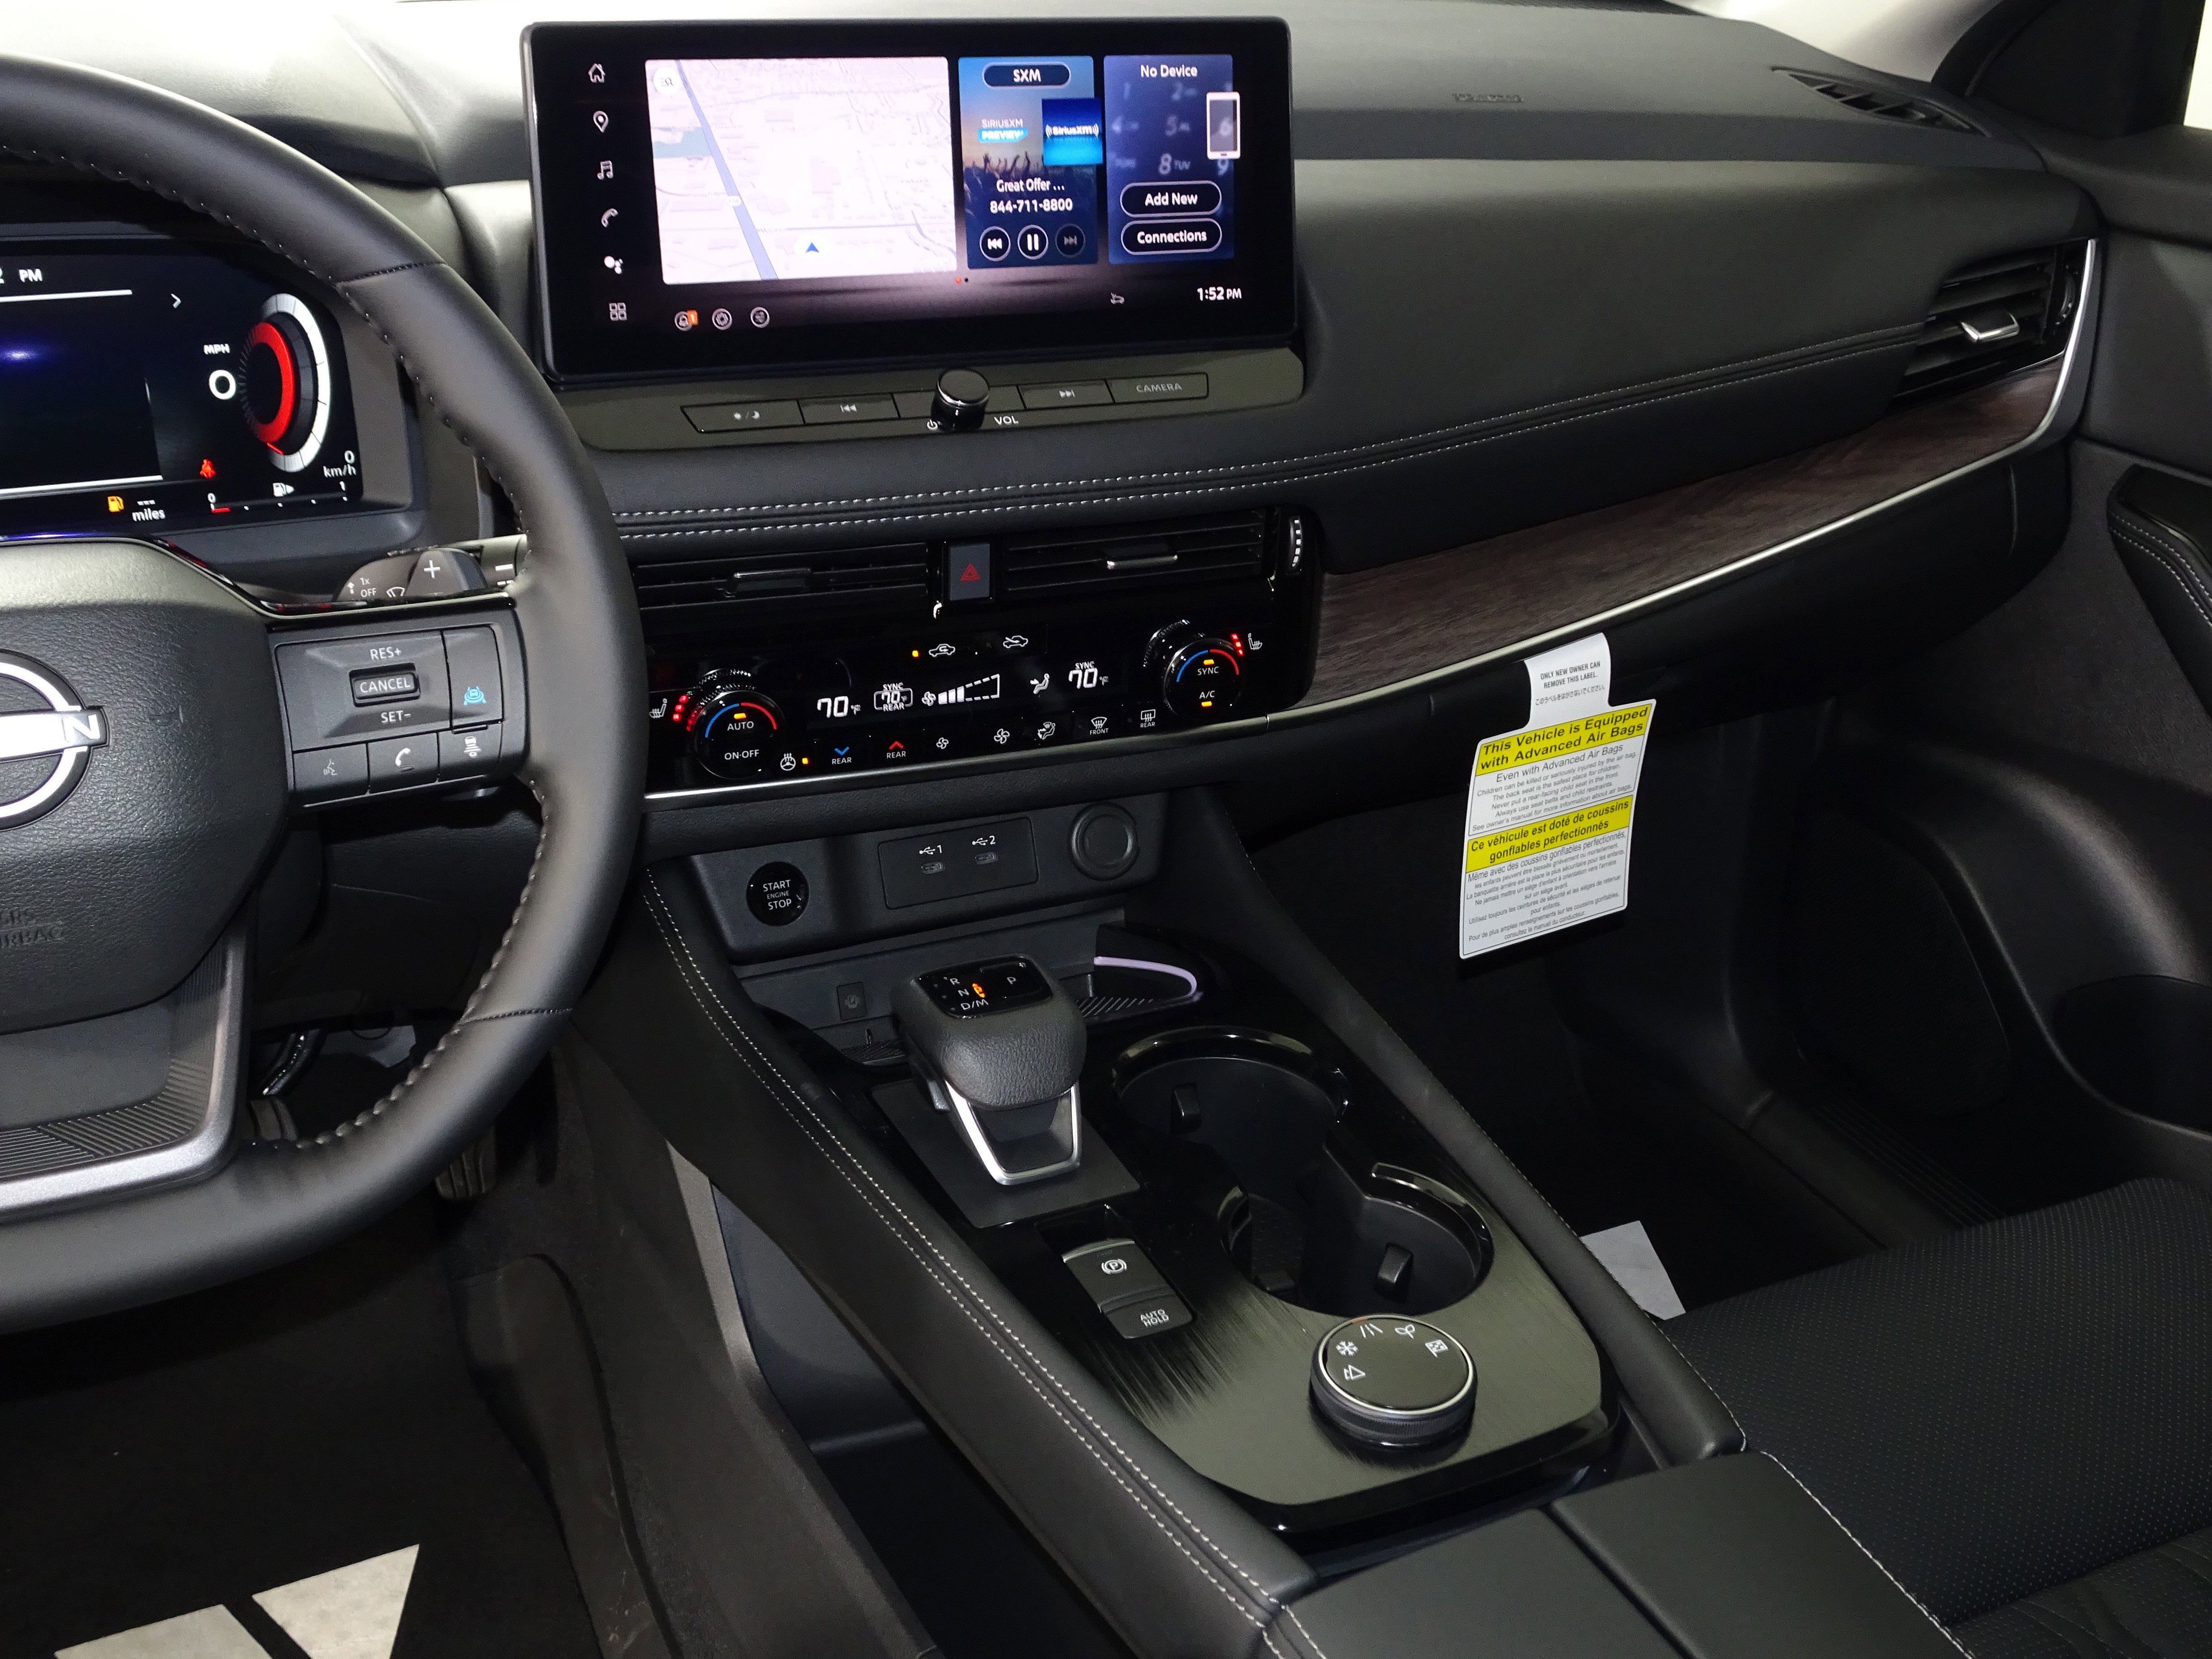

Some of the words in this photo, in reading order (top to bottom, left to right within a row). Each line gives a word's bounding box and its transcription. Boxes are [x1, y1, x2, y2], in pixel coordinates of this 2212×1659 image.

[1013, 69, 1041, 82] SXM
[1140, 65, 1157, 77] No
[1161, 65, 1198, 77] Device
[982, 118, 1023, 128] SIRIUSXM
[997, 179, 1023, 192] Great
[1026, 178, 1050, 192] Offer
[990, 197, 1073, 213] 844-711-8800
[1145, 193, 1169, 206] Add
[1172, 192, 1198, 206] New
[1137, 230, 1207, 244] Connections
[19, 268, 43, 282] PM
[1197, 287, 1224, 301] 1:52
[1226, 288, 1242, 300] PM
[204, 344, 230, 355] MPH
[1136, 383, 1182, 393] CAMERA
[994, 416, 1019, 426] VOL
[344, 450, 354, 464] 0
[323, 464, 356, 478] km/h
[132, 508, 165, 522] miles
[361, 588, 376, 597] OFF
[370, 647, 402, 660] RES+
[1075, 661, 1095, 670] SYNC
[1197, 666, 1219, 675] SYNC
[1540, 671, 1554, 680] ONLY
[1555, 668, 1568, 677] NEW
[1569, 663, 1589, 673] OWNER
[1589, 661, 1601, 669] CAN
[1069, 668, 1098, 689] 70
[1543, 678, 1565, 689] REMOVE
[1567, 675, 1579, 684] THIS
[360, 678, 411, 694] CANCEL
[883, 682, 904, 691] SYNC
[1199, 690, 1215, 699] A/C
[817, 696, 849, 718] 70
[883, 703, 905, 712] REAR
[727, 721, 754, 731] AUTO
[1089, 727, 1109, 736] FRONT
[1483, 741, 1511, 755] This
[1516, 727, 1565, 746] Vehicle
[1569, 724, 1579, 734] is
[1584, 707, 1648, 730] Equipped
[1481, 755, 1508, 769] with
[1514, 736, 1581, 761] Advanced
[1586, 731, 1605, 744] Air
[1611, 723, 1643, 737] Bags
[831, 756, 852, 765] REAR
[886, 750, 906, 759] REAR
[1496, 771, 1518, 782] Even
[1522, 765, 1539, 776] with
[1542, 752, 1585, 771] Advanced
[1588, 750, 1599, 759] Air
[1602, 745, 1622, 755] Bags
[1477, 786, 1502, 796] Children
[1526, 776, 1542, 784] killed
[1550, 767, 1576, 778] seriously
[1577, 761, 1597, 772] injured
[1505, 789, 1520, 798] back
[1522, 786, 1534, 794] seat
[1553, 777, 1570, 786] safest
[1571, 773, 1587, 781] place
[1491, 801, 1509, 810] Never
[1511, 797, 1521, 806] put
[1560, 783, 1574, 792] child
[1575, 780, 1587, 788] seat
[1495, 808, 1517, 817] Always
[1530, 800, 1543, 808] seat
[1544, 797, 1558, 805] belts
[1560, 792, 1570, 800] and
[1572, 788, 1585, 797] child
[1510, 810, 1532, 821] manual
[1543, 805, 1558, 813] more
[1559, 796, 1590, 808] information
[1592, 790, 1607, 799] about
[1471, 840, 1484, 851] Ce
[1487, 828, 1528, 847] véhicule
[1532, 823, 1546, 835] est
[1549, 815, 1570, 830] doté
[1573, 813, 1584, 823] de
[1587, 801, 1629, 819] coussins
[989, 836, 996, 845] 2
[1490, 840, 1540, 863] gonflables
[1543, 820, 1608, 848] perfectionnés
[1468, 871, 1488, 882] Même
[1490, 866, 1505, 876] avec
[1507, 862, 1518, 871] des
[1520, 853, 1548, 867] coussins
[1549, 844, 1581, 860] gonflables
[763, 879, 791, 893] START
[767, 890, 790, 900] ENGINE
[767, 898, 792, 911] STOP
[950, 978, 961, 986] R
[1007, 976, 1017, 985] P
[958, 989, 970, 997] N
[961, 999, 989, 1010] D/M
[1140, 1309, 1166, 1322] AUTO
[1143, 1314, 1169, 1328] HOLD
